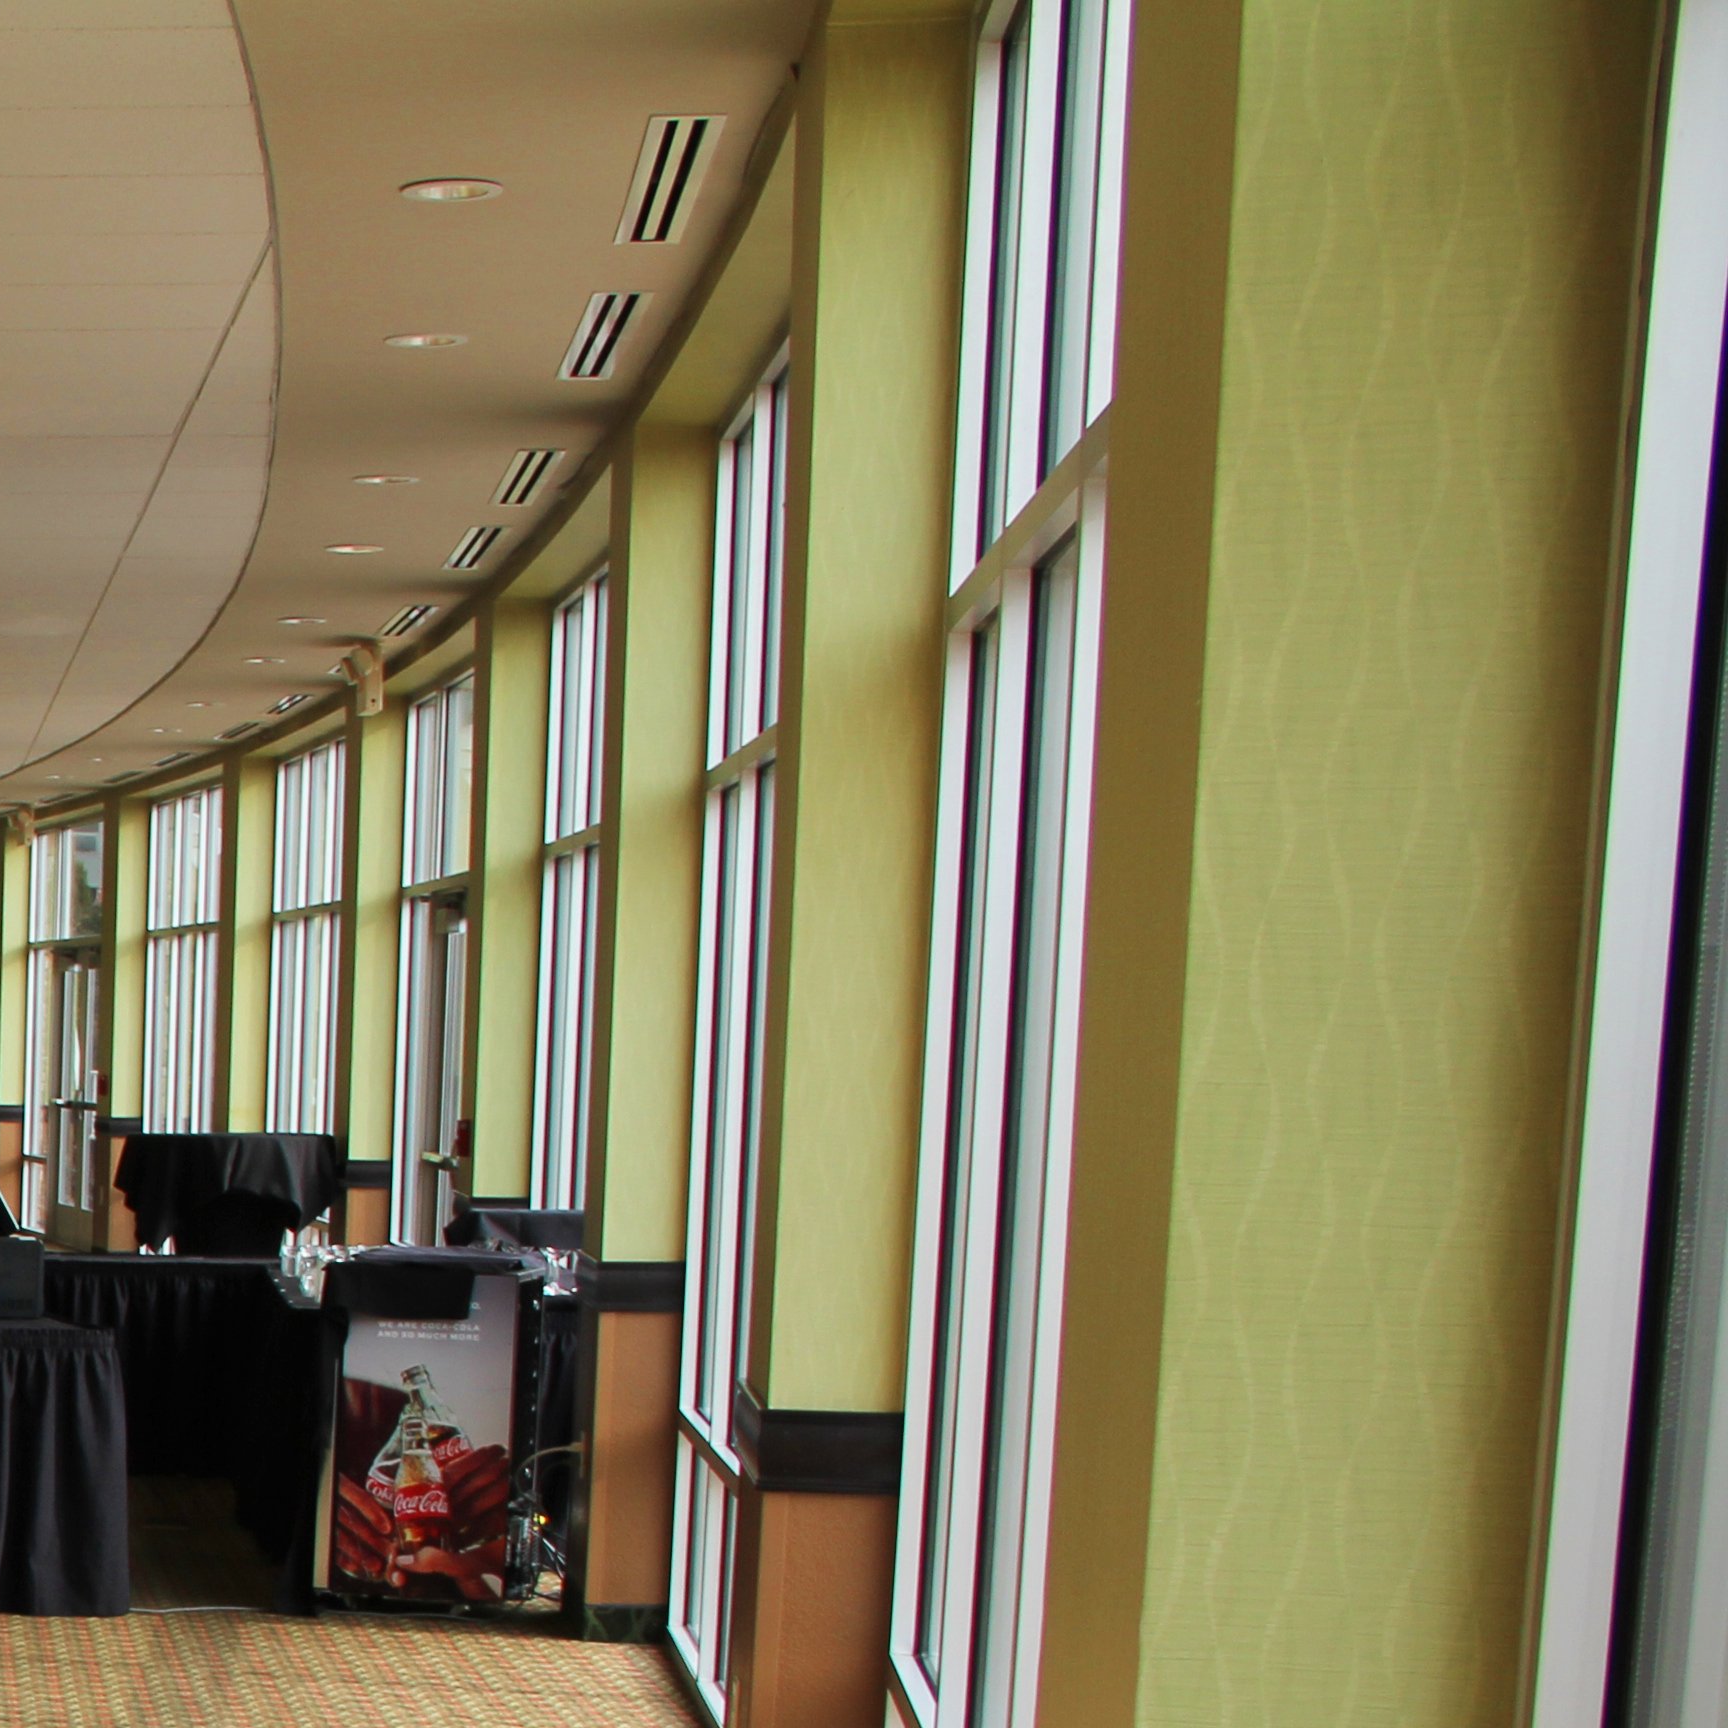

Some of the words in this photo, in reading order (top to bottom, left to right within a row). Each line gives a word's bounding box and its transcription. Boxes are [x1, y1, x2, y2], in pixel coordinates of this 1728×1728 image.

[398, 1322, 418, 1330] ARE
[421, 1322, 481, 1332] COCA-COLA
[377, 1330, 399, 1339] AND
[401, 1331, 415, 1339] SO
[417, 1331, 447, 1340] MUCH
[449, 1332, 480, 1341] MORE
[393, 1489, 449, 1518] Coca-Cola
